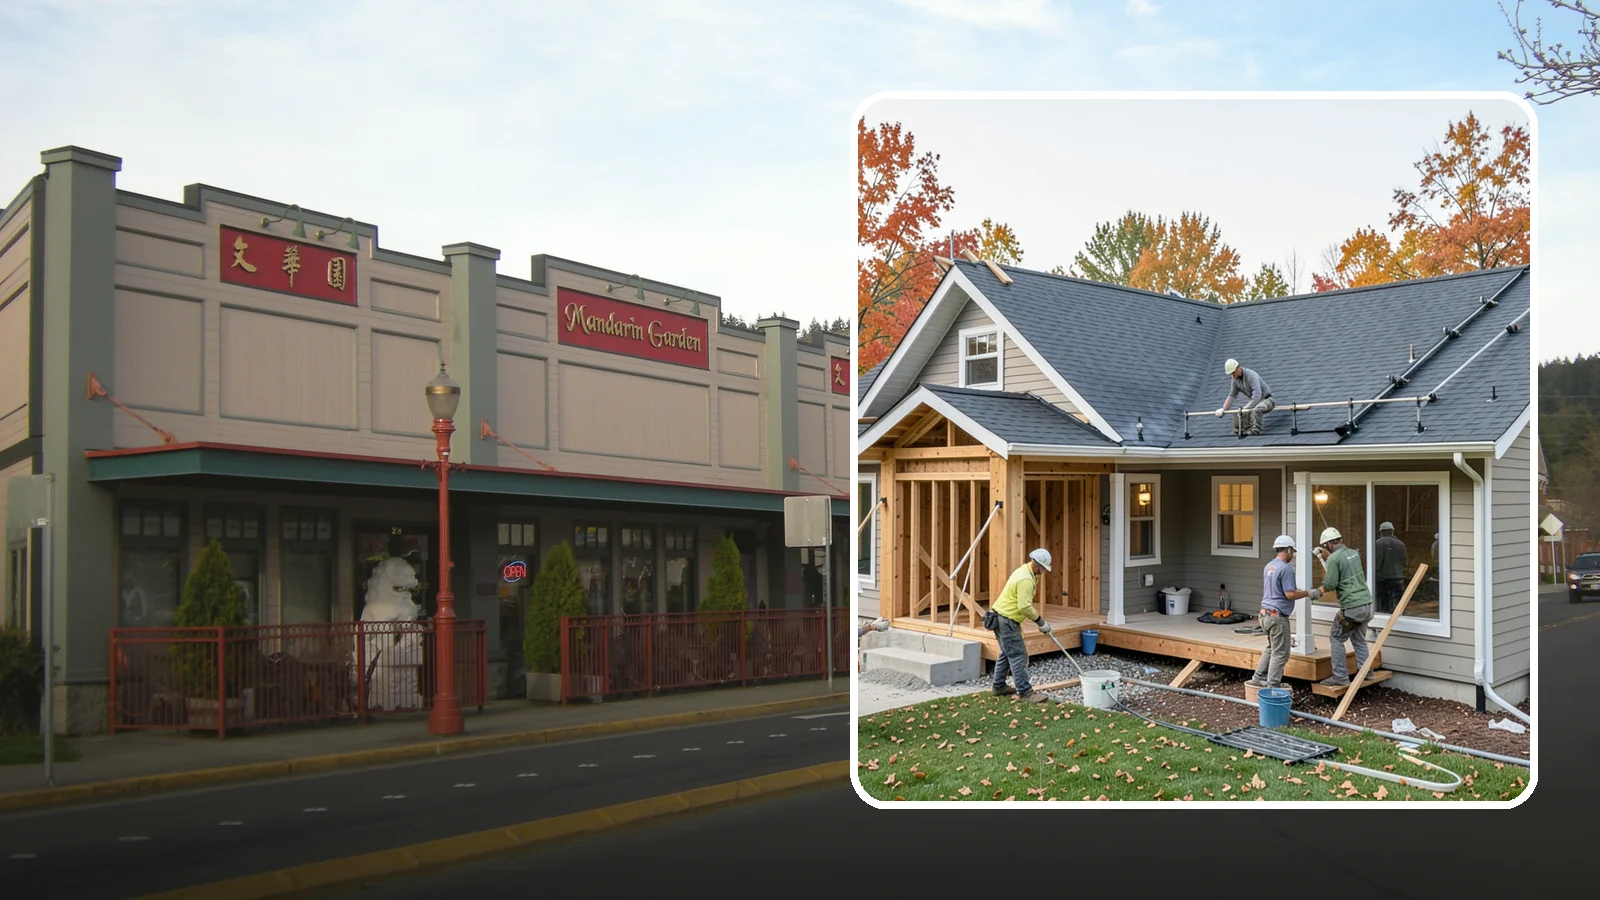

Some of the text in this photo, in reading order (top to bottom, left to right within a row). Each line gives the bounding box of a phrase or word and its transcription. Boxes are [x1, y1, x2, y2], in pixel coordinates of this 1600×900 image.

[231, 236, 346, 290] 文華園
[565, 302, 701, 352] Mandarin Garden
[503, 565, 527, 579] OPEN
